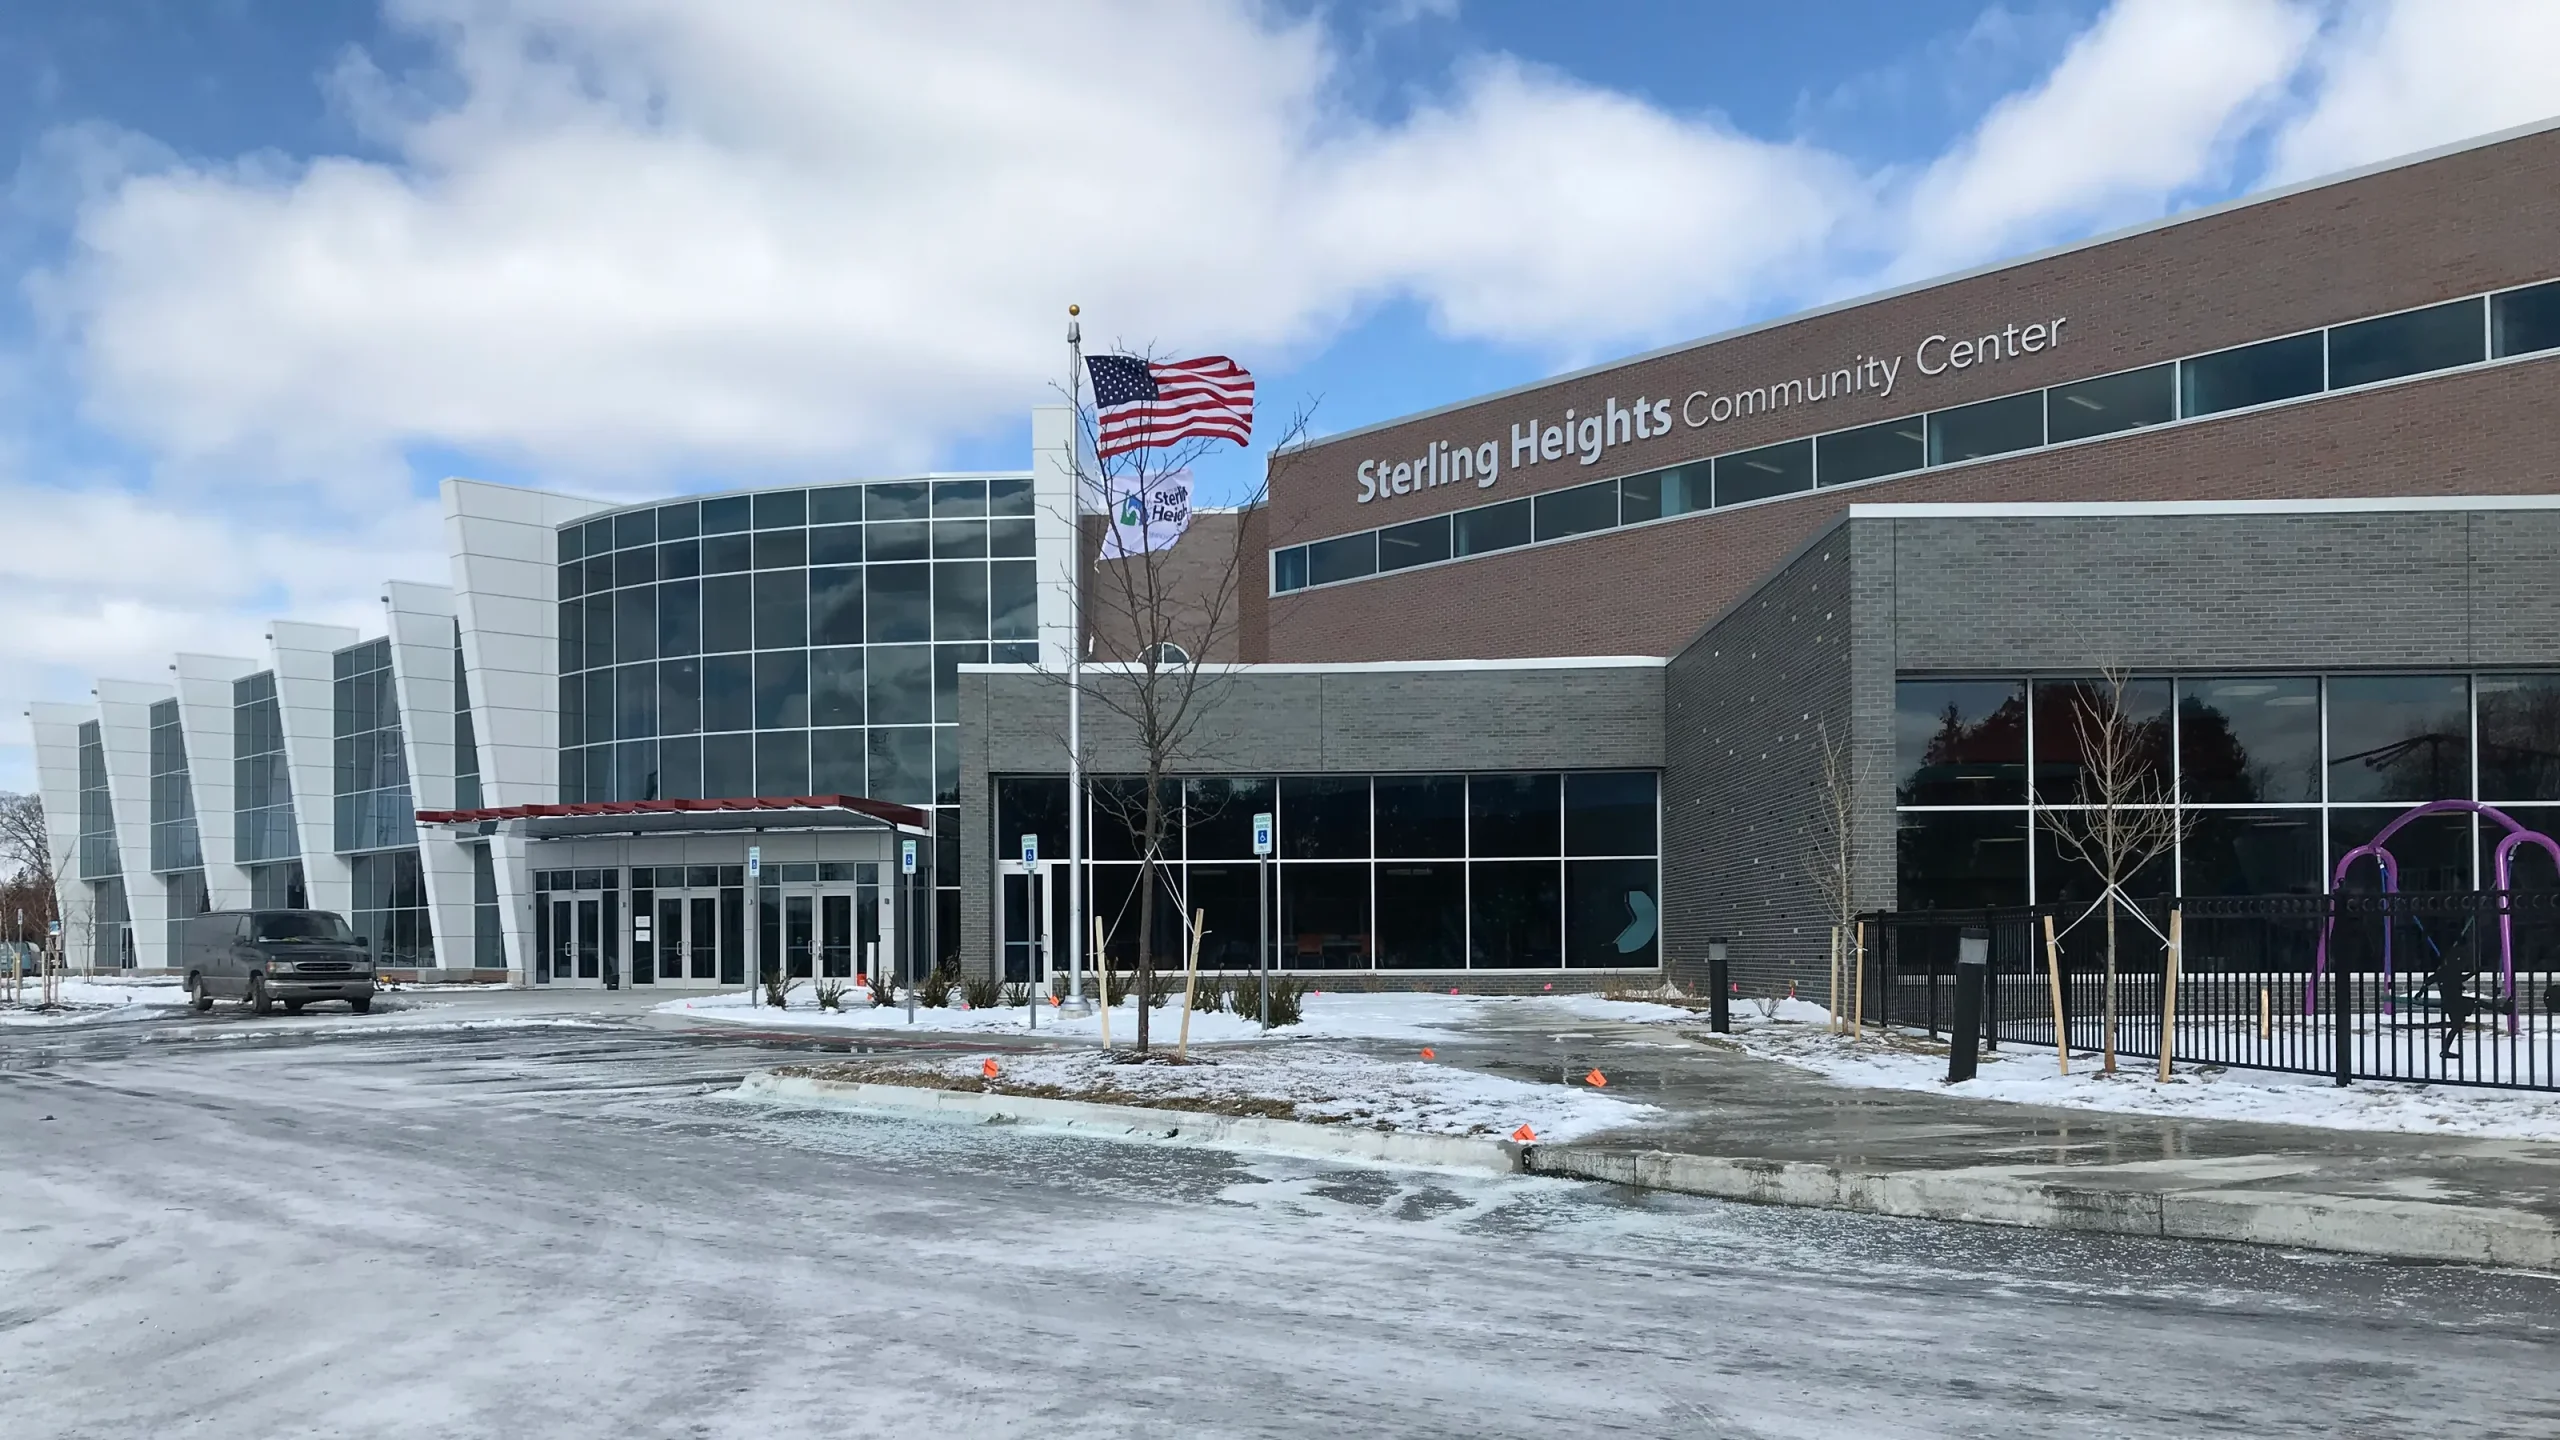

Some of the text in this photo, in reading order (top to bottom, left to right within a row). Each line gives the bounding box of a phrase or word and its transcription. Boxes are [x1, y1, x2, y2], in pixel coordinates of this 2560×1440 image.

[1357, 317, 2067, 504] Sterling Heights Community Center
[1152, 503, 1187, 526] Heigh
